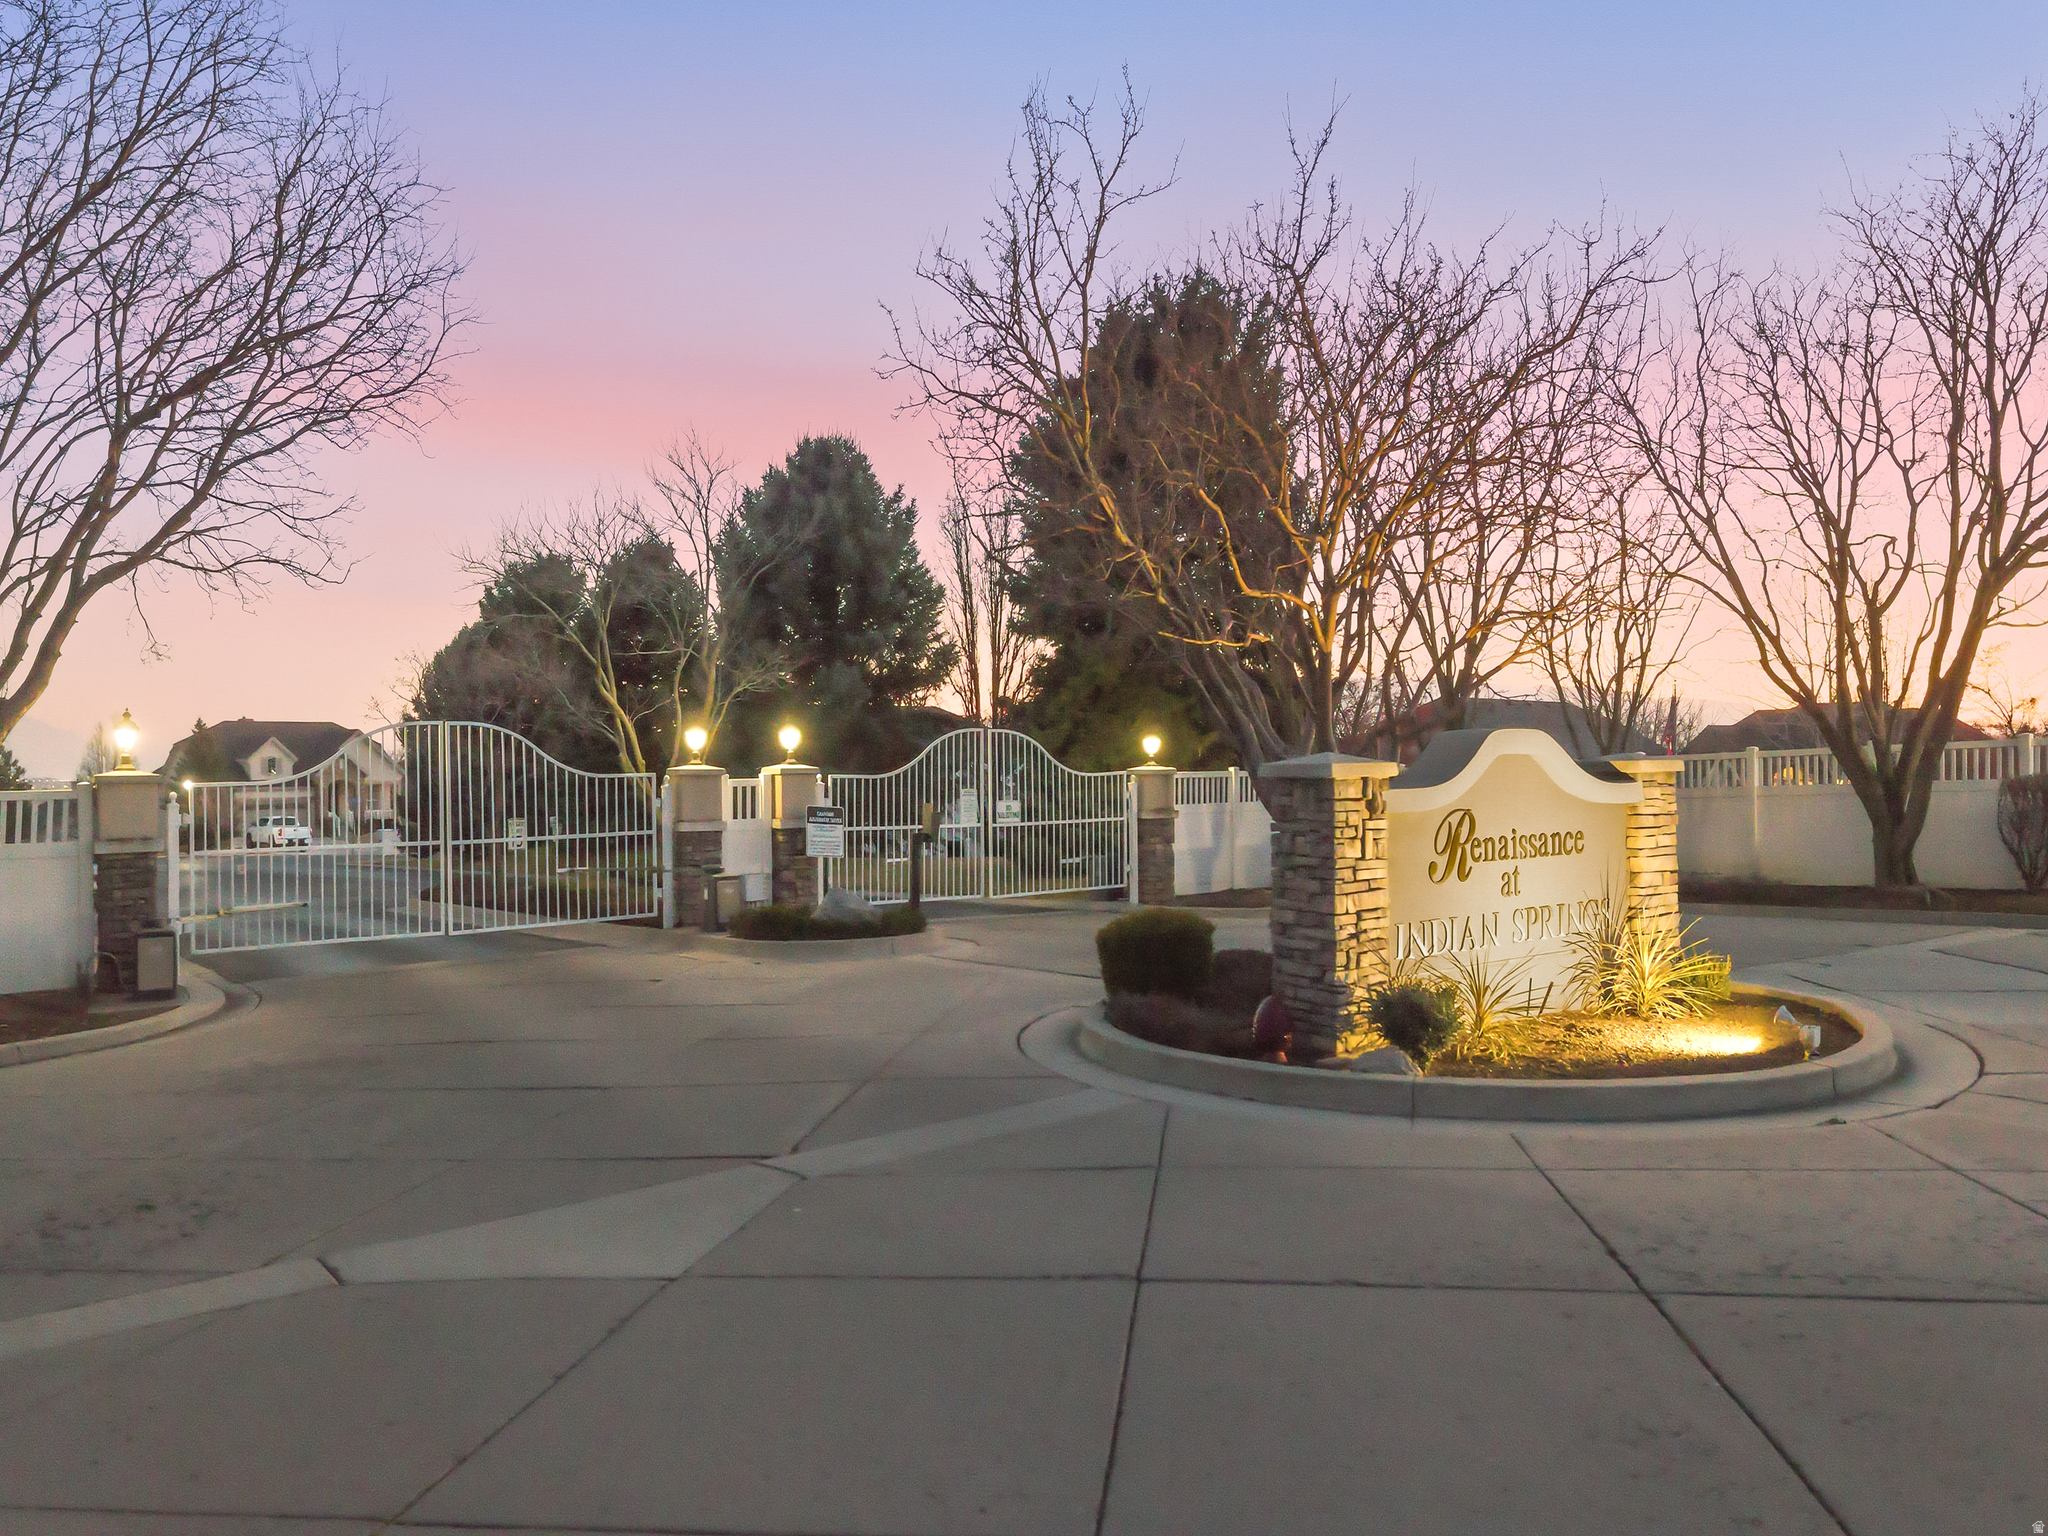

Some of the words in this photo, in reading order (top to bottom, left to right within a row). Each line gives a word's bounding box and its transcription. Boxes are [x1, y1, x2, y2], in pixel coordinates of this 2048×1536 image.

[1428, 808, 1585, 884] Renaissance
[1500, 865, 1521, 897] at
[1395, 911, 1500, 961] INDIAN
[1512, 898, 1610, 944] SPRINGS
